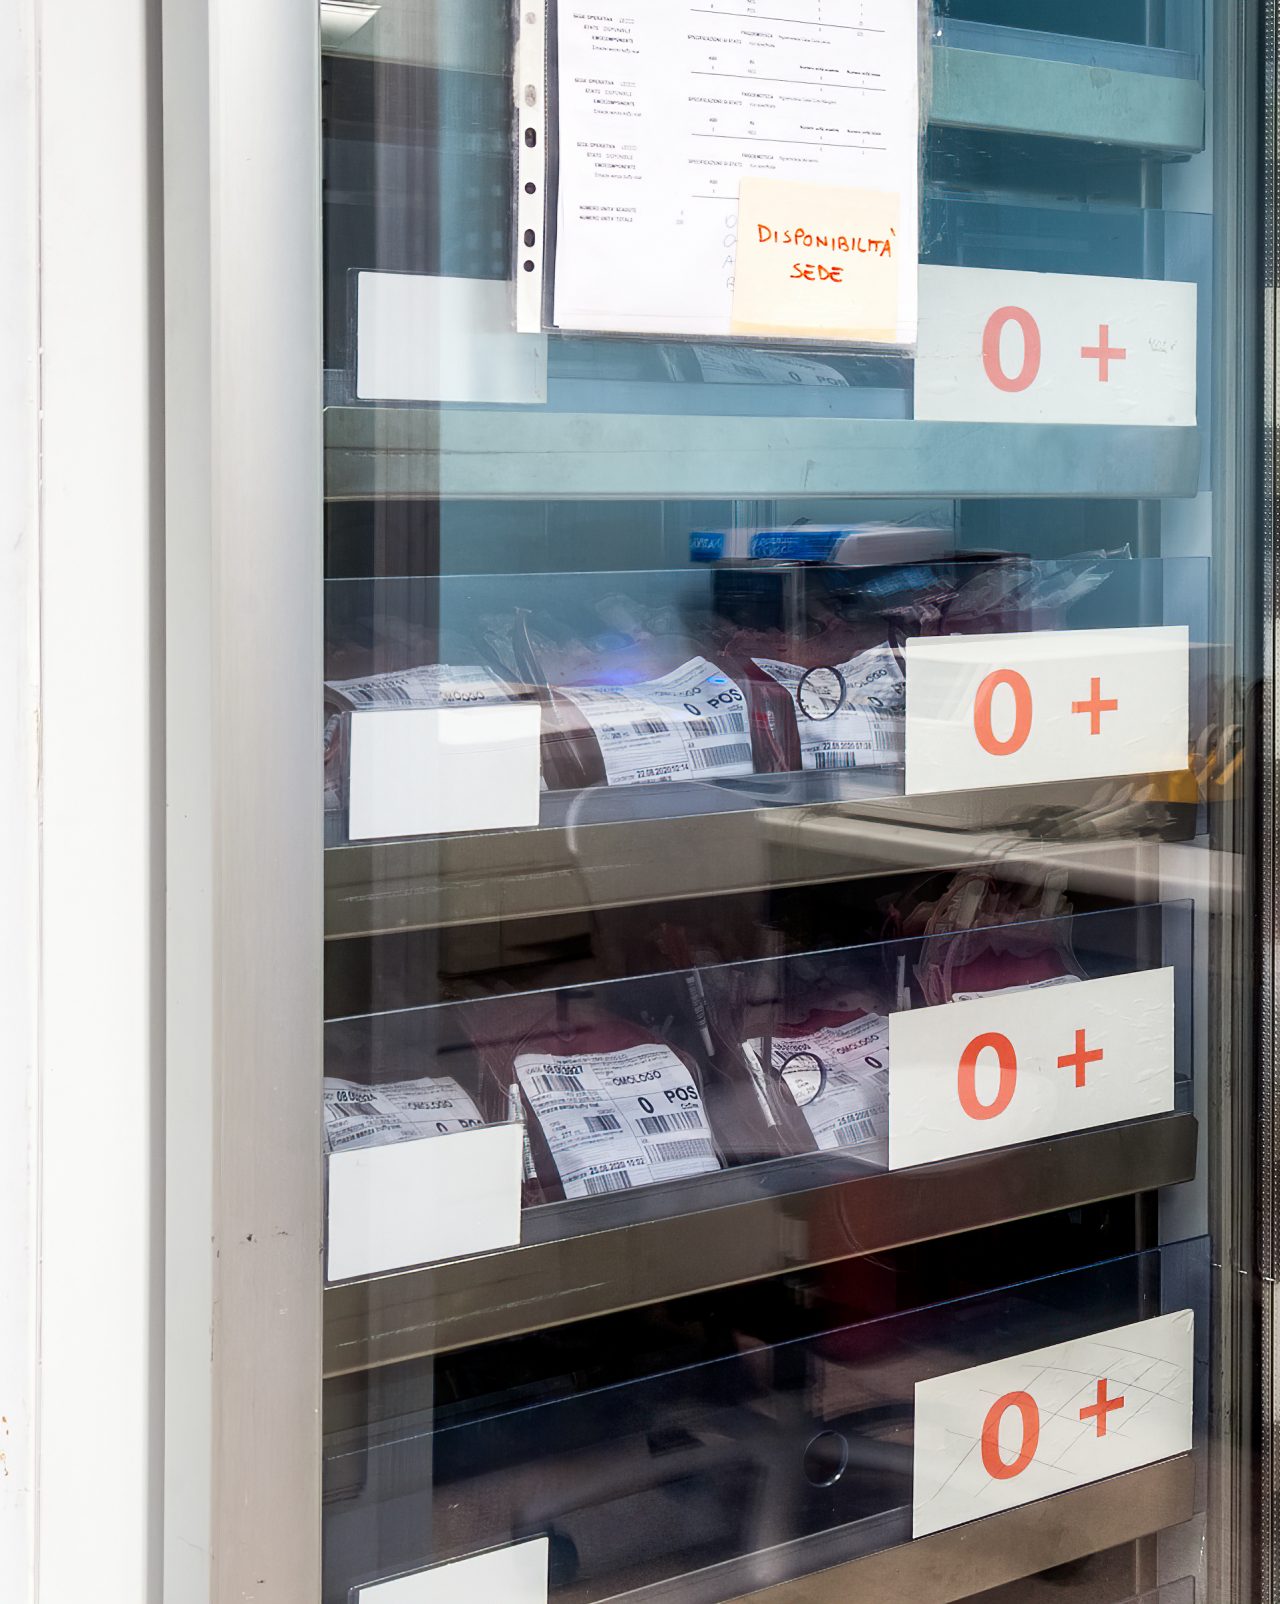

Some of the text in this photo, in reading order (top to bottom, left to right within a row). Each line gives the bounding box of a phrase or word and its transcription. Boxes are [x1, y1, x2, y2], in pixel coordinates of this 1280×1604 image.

[789, 263, 844, 282] SEDE
[1081, 324, 1126, 382] +
[707, 688, 743, 709] POS
[1071, 677, 1118, 735] +
[612, 1070, 661, 1086] OMOLOGO
[1057, 1029, 1103, 1088] +
[664, 1085, 698, 1104] POS
[1079, 1378, 1124, 1438] +
